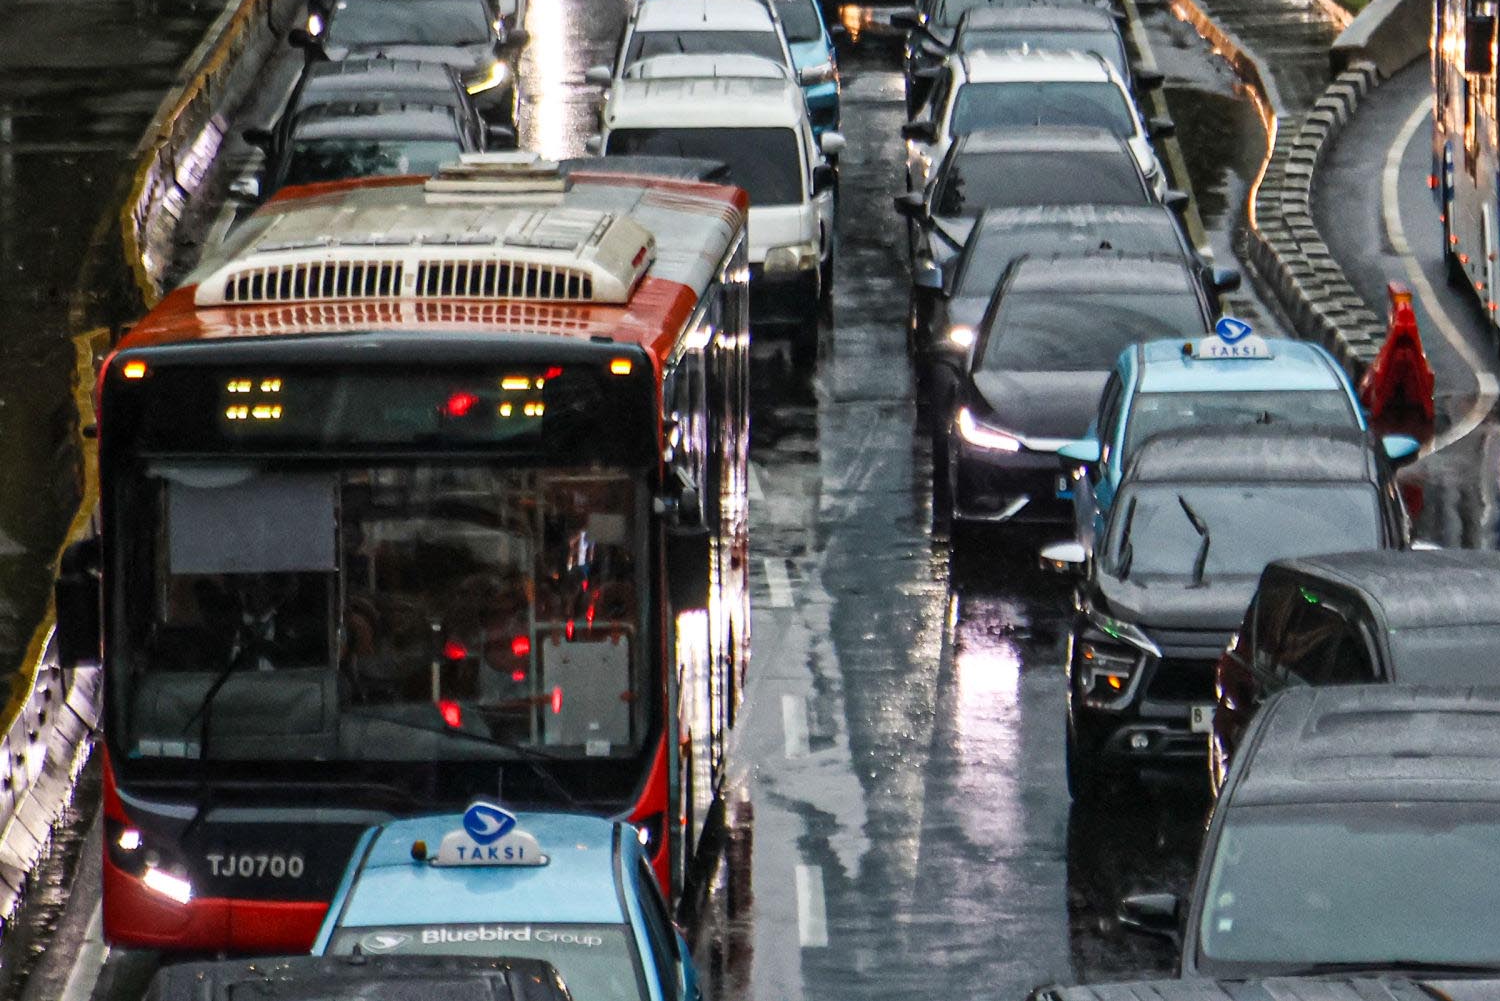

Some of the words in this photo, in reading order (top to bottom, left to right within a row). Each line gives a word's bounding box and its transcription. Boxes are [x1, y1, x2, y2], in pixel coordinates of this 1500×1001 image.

[1211, 345, 1257, 356] TAKSI
[456, 846, 525, 860] TAKSI
[206, 855, 304, 878] TJ0700
[421, 925, 531, 944] Bluebird
[535, 929, 602, 948] Group
